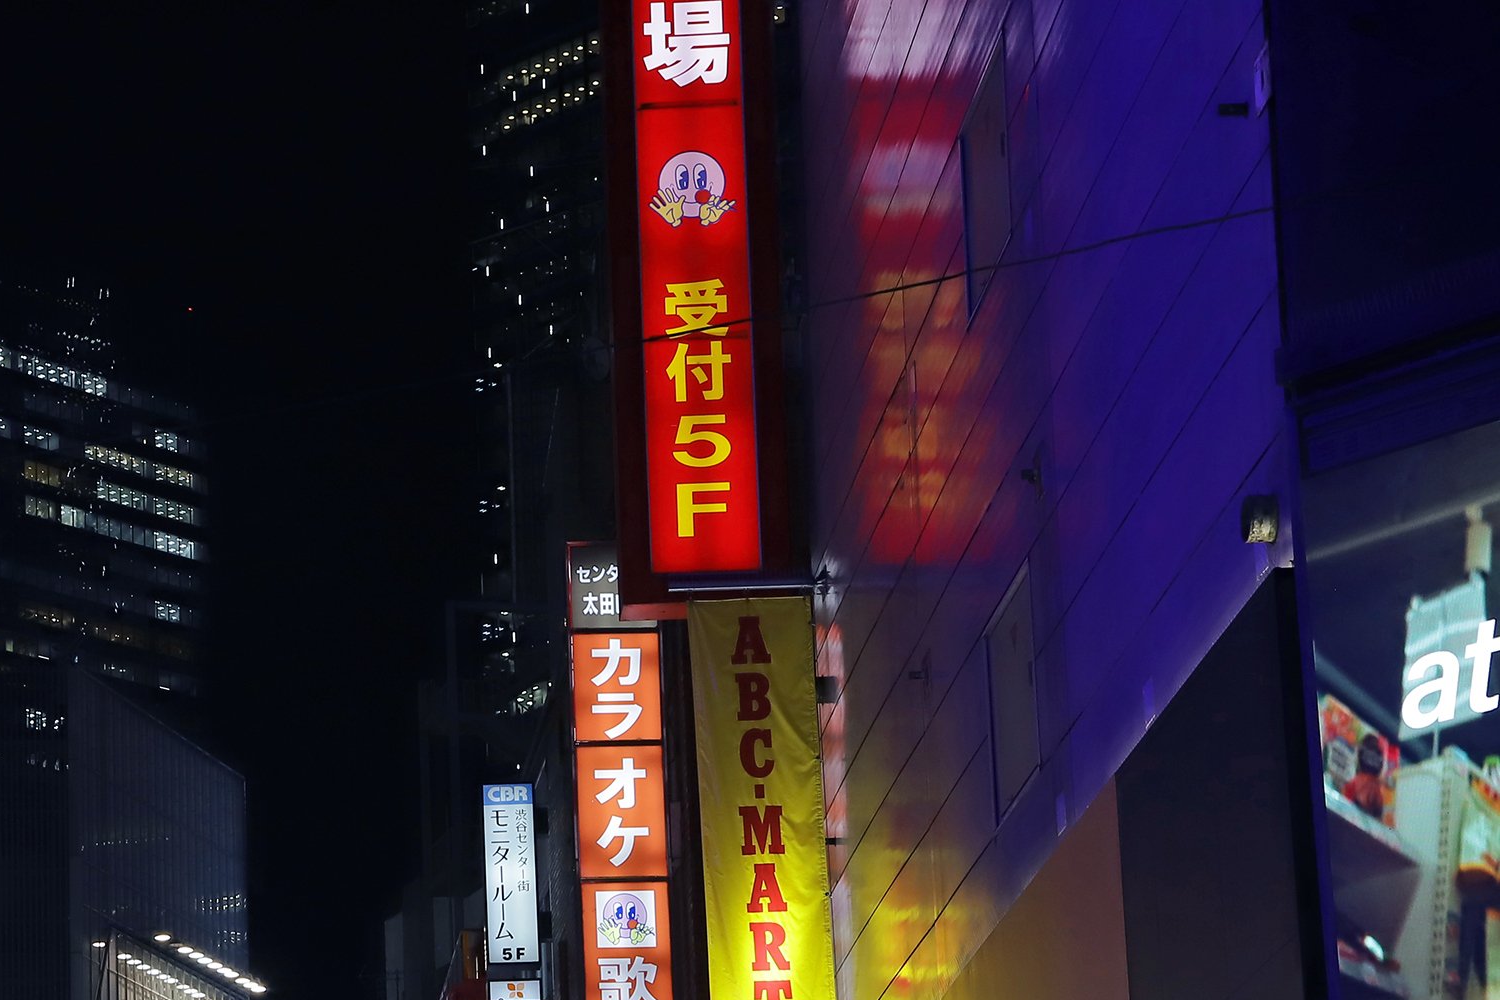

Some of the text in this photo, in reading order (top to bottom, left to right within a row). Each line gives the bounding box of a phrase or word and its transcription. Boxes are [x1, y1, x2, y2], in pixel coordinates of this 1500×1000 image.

[642, 0, 731, 87] 場
[664, 278, 732, 538] 受付5F
[583, 592, 620, 616] 太田
[487, 786, 528, 802] CBR
[591, 639, 649, 868] カラオケ
[490, 809, 514, 940] モニタールーム
[515, 809, 530, 893] 渋谷センター街
[502, 948, 525, 960] 5F
